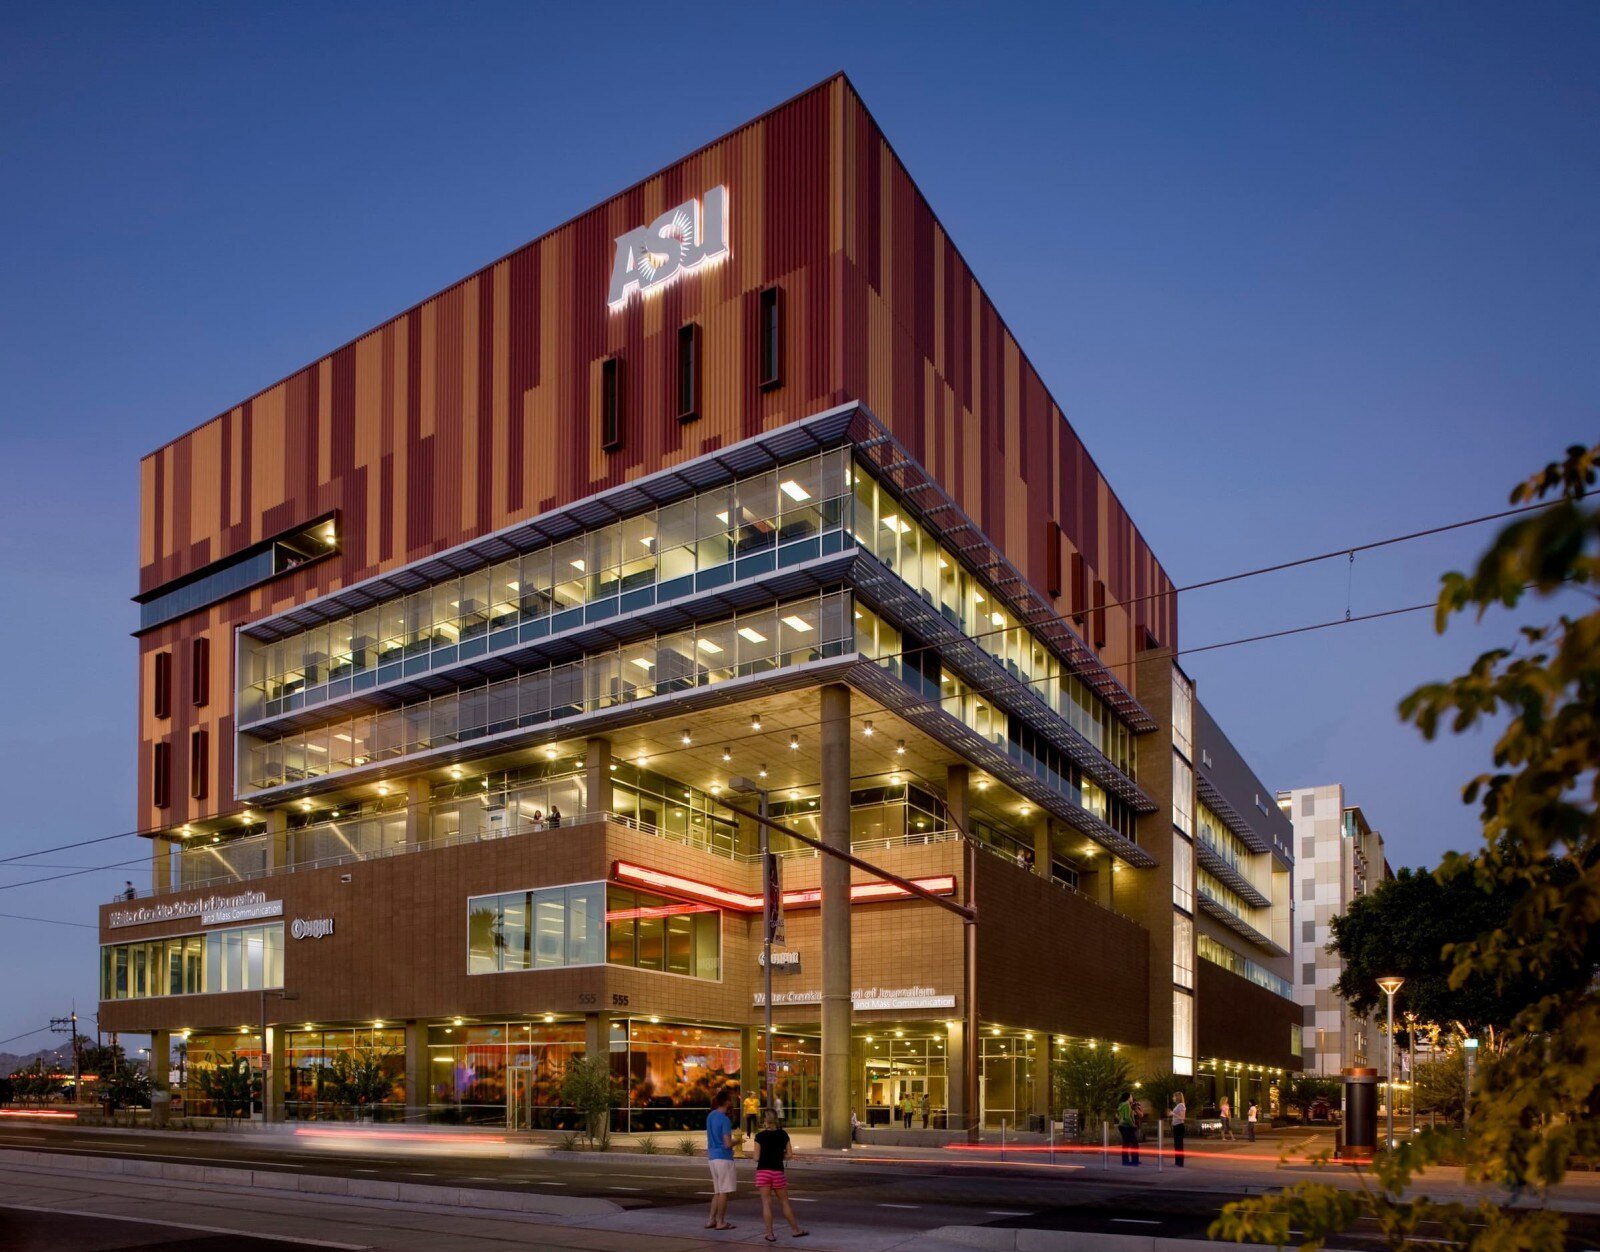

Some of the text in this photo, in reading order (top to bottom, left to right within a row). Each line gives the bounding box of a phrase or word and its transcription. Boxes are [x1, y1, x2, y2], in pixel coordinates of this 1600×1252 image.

[607, 184, 729, 307] ASU
[204, 896, 214, 911] of
[215, 889, 266, 909] Journalism
[203, 904, 281, 924] and Mass Communication
[578, 993, 597, 1004] 555
[864, 987, 876, 999] of
[877, 986, 936, 999] Journalism
[612, 993, 629, 1006] 555
[855, 997, 954, 1009] and Mass Communication
